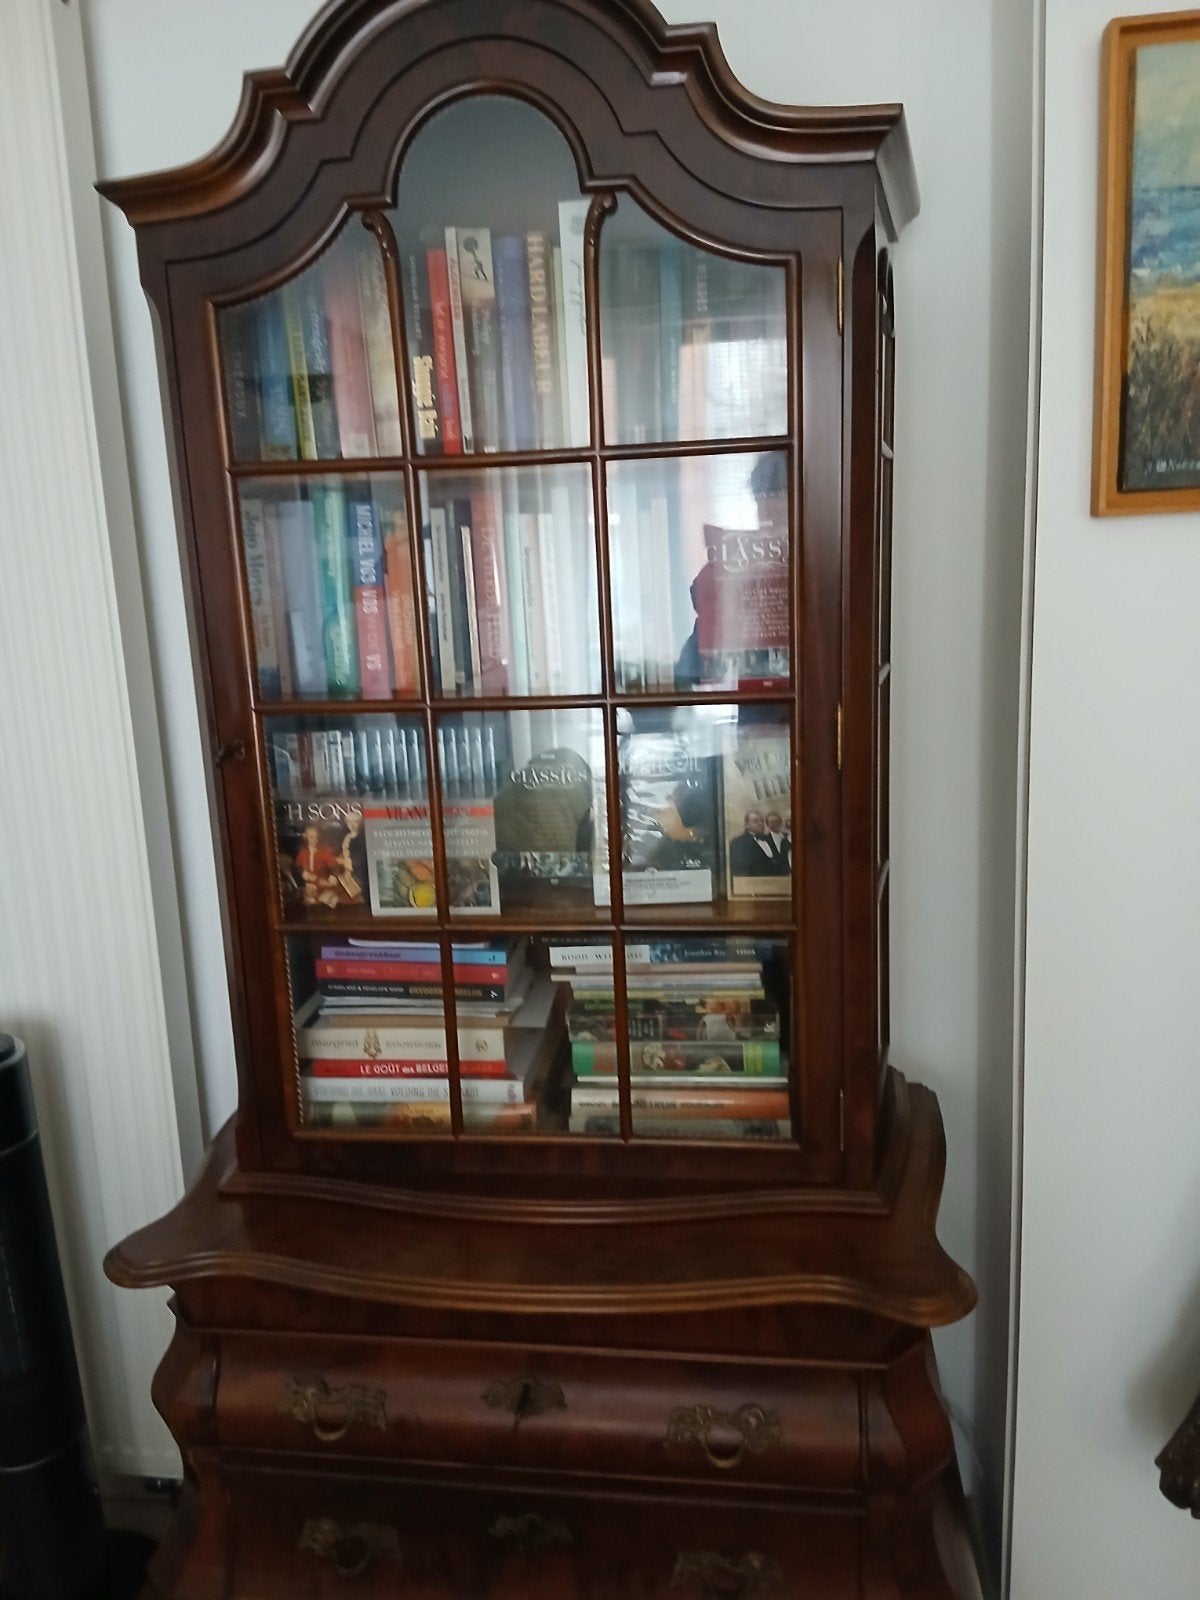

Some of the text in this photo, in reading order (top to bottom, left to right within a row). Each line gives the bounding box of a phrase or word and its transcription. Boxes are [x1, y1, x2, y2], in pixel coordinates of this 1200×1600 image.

[510, 765, 588, 789] CLASSICS
[284, 803, 304, 821] H
[360, 1064, 371, 1075] LE
